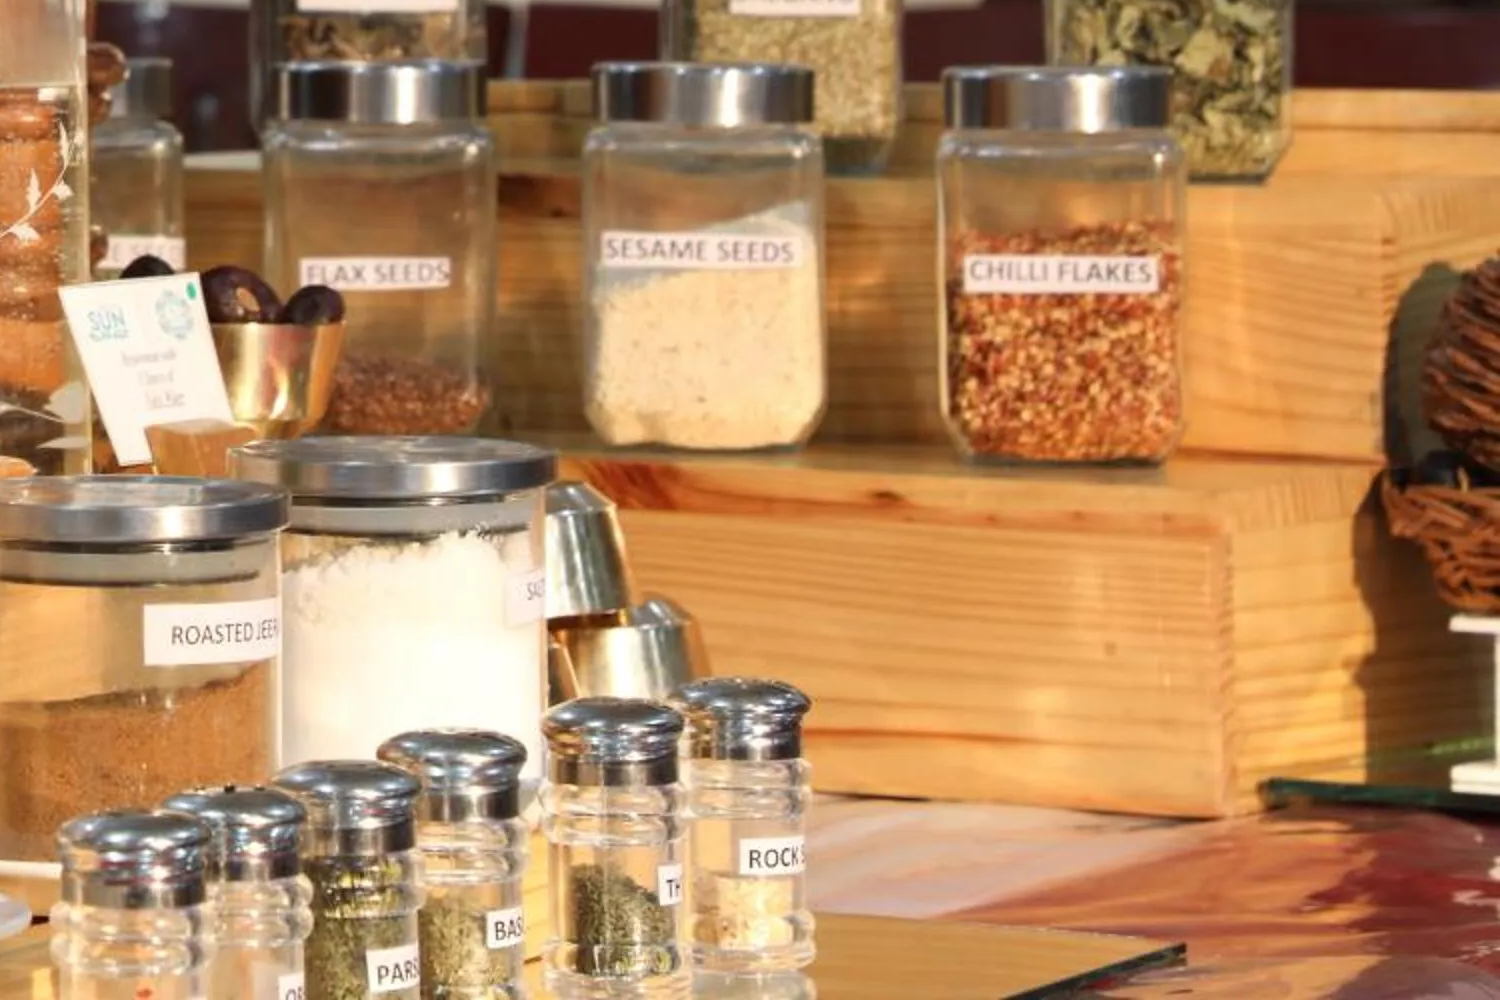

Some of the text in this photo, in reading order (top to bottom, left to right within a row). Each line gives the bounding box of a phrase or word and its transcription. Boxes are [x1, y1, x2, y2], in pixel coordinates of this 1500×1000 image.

[607, 238, 795, 263] SESAME SEEDS
[306, 259, 450, 284] FLAX SEEDS
[969, 260, 1153, 284] CHILLI FLAKES
[87, 308, 127, 331] SUN
[170, 621, 255, 645] ROASTED
[749, 846, 799, 869] ROCK
